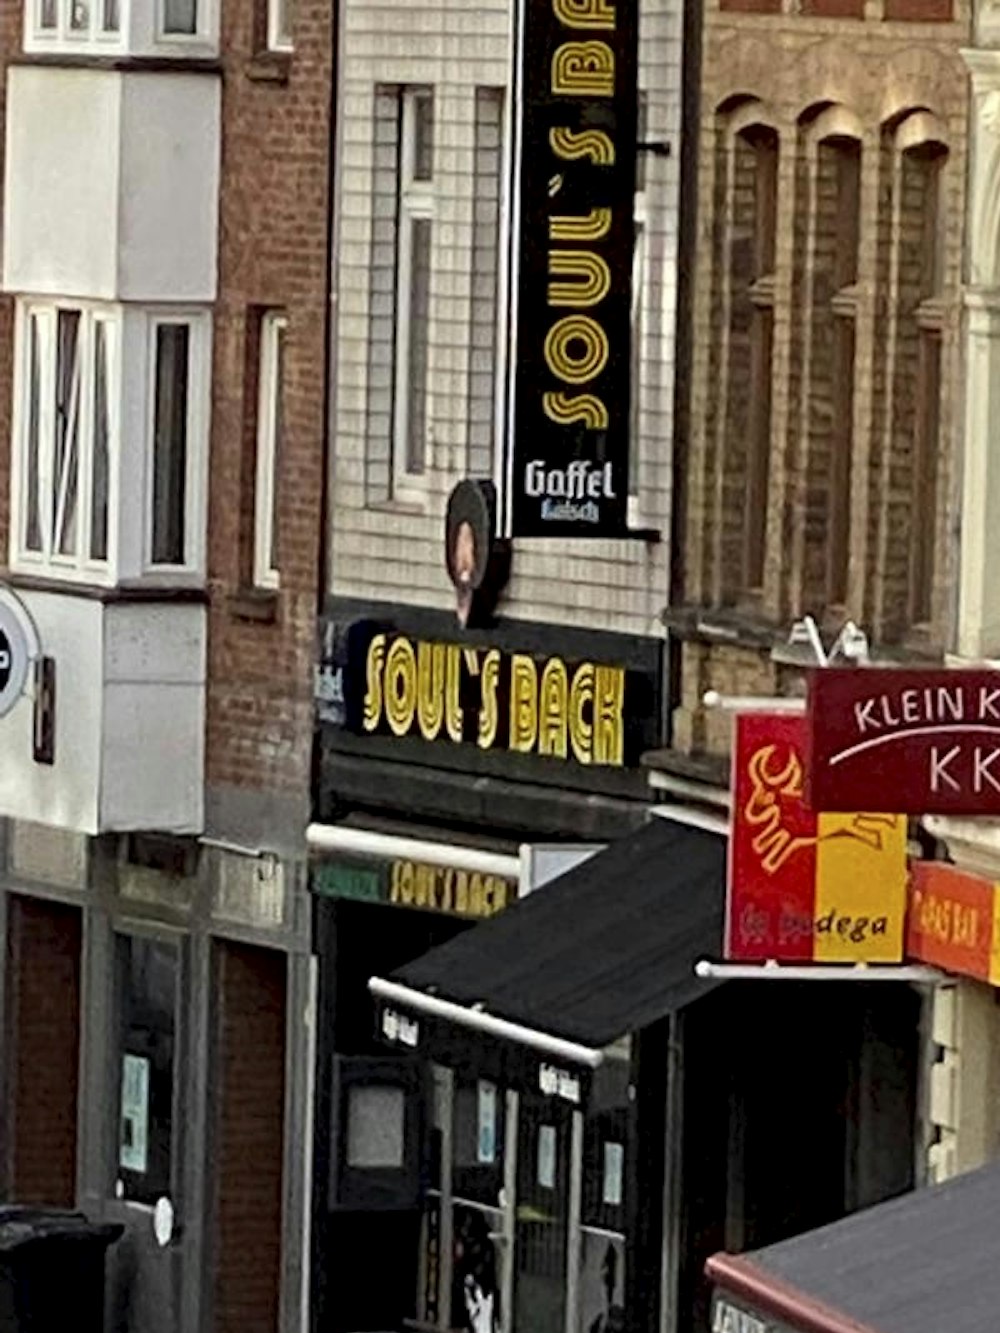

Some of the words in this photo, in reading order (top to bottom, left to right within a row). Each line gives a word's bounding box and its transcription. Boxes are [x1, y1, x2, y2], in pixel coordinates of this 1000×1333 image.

[524, 460, 617, 499] Gaffel
[509, 653, 625, 767] BACK
[854, 687, 964, 734] KLEIN
